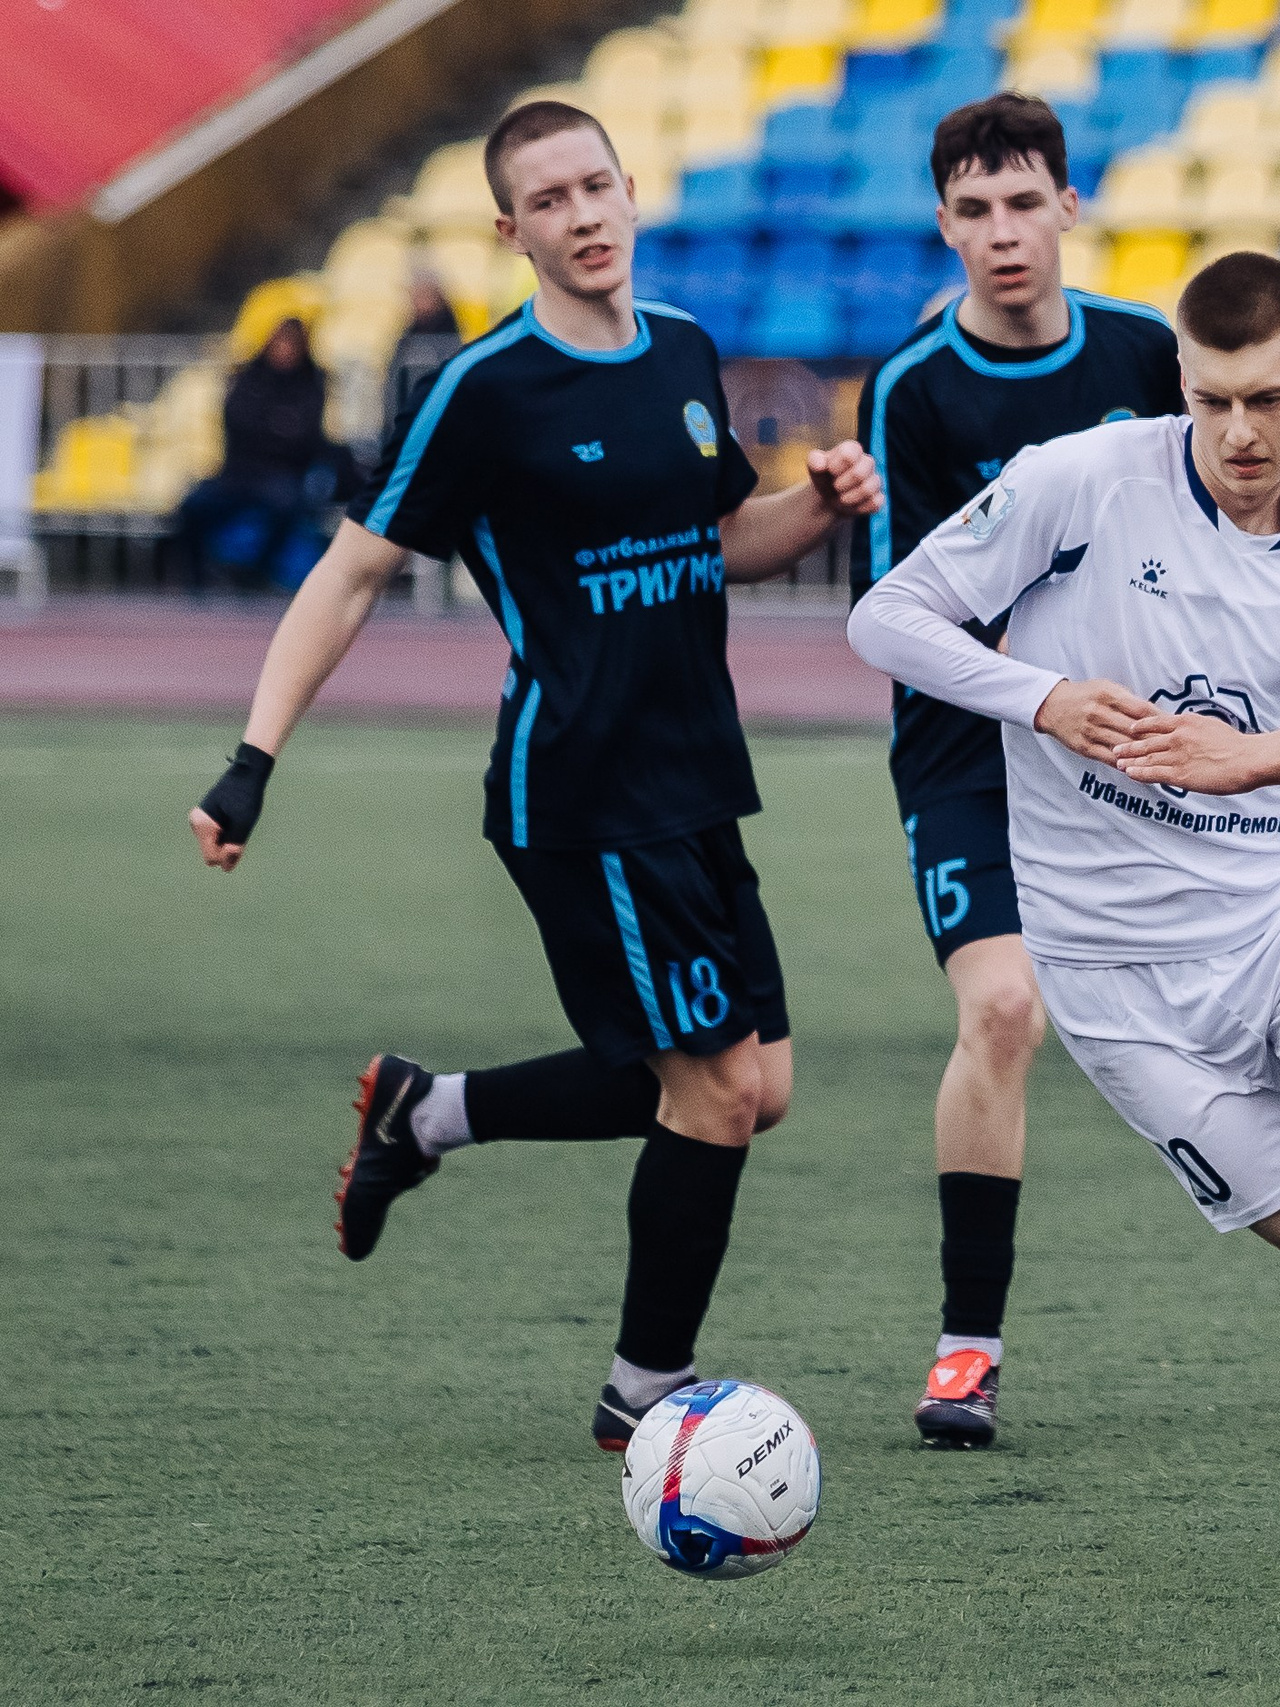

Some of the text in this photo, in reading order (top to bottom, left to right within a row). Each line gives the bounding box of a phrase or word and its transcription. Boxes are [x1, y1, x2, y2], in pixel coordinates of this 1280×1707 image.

[1129, 578, 1168, 600] KELME
[924, 858, 971, 938] 15
[666, 956, 730, 1034] 18
[735, 1419, 794, 1479] DEMIX
